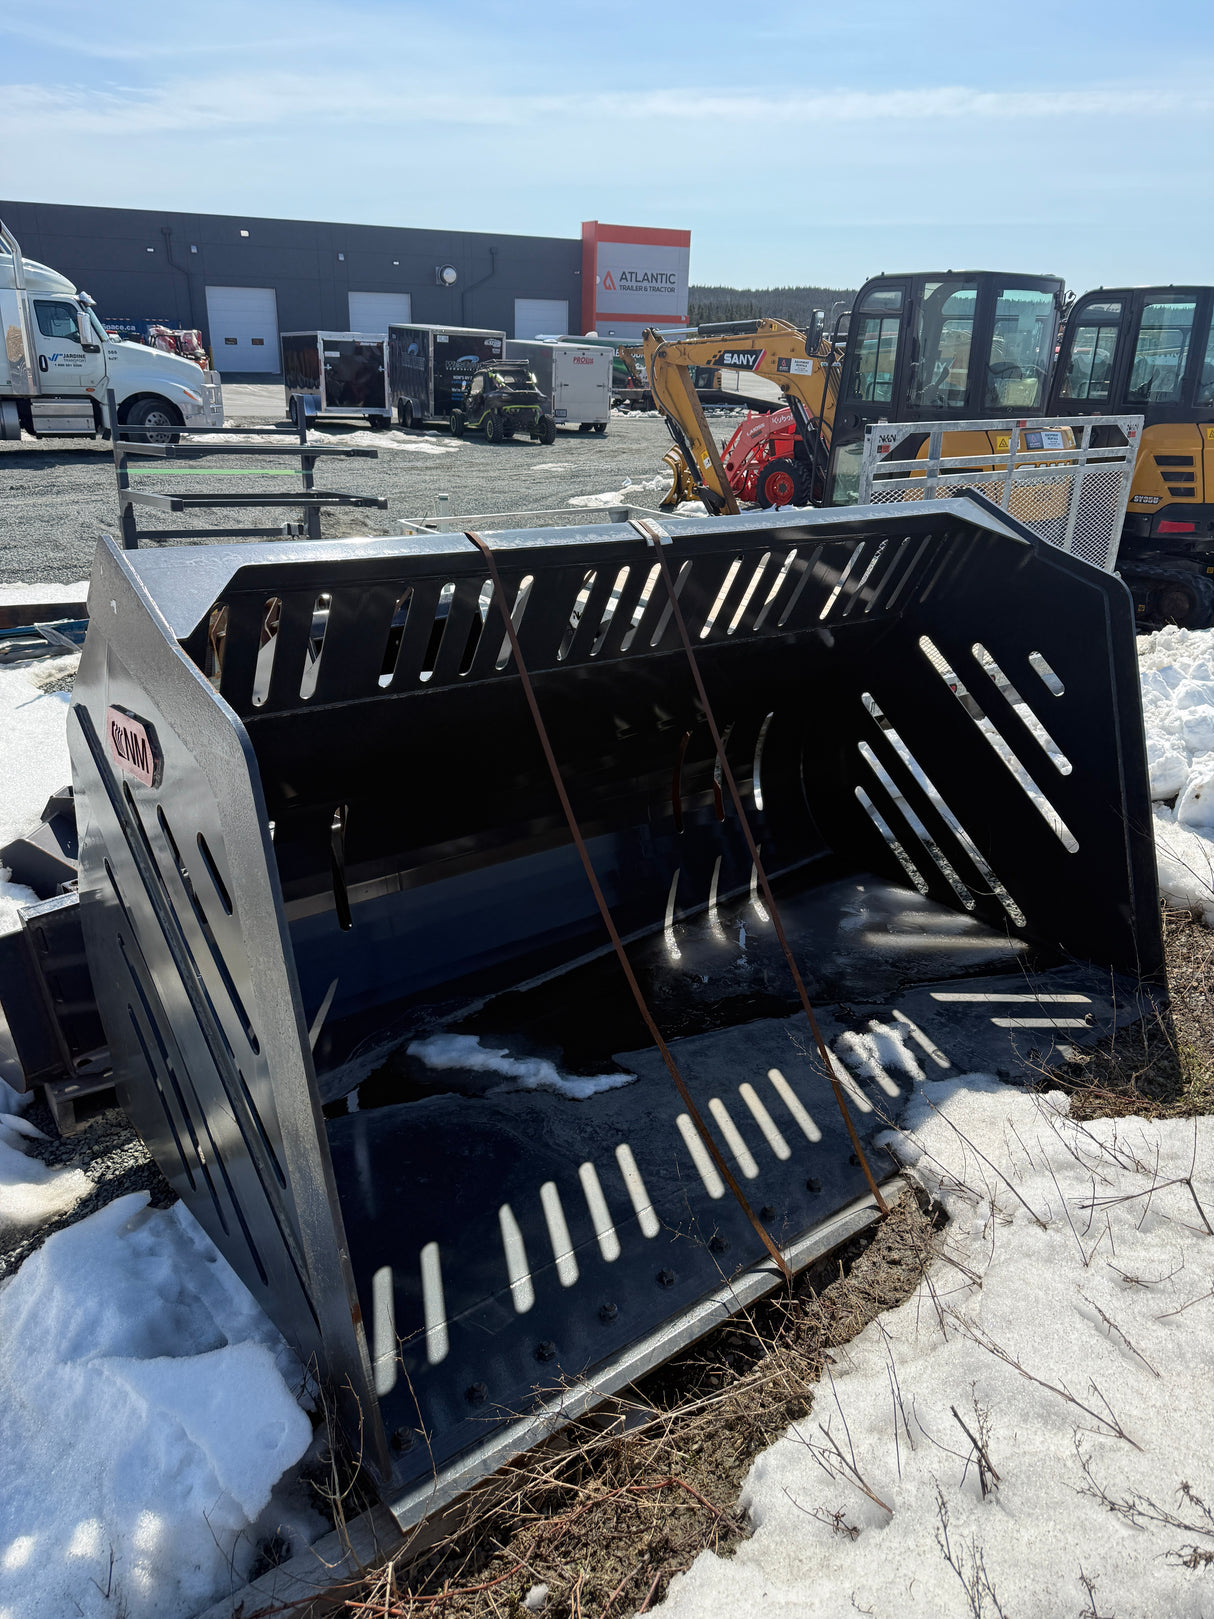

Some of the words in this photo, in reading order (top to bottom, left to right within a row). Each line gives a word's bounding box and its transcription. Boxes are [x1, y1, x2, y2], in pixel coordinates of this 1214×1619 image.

[619, 271, 676, 284] ATLANTIC
[619, 284, 643, 292] TRAILER
[649, 285, 676, 293] TRACTOR
[723, 353, 757, 366] SANY
